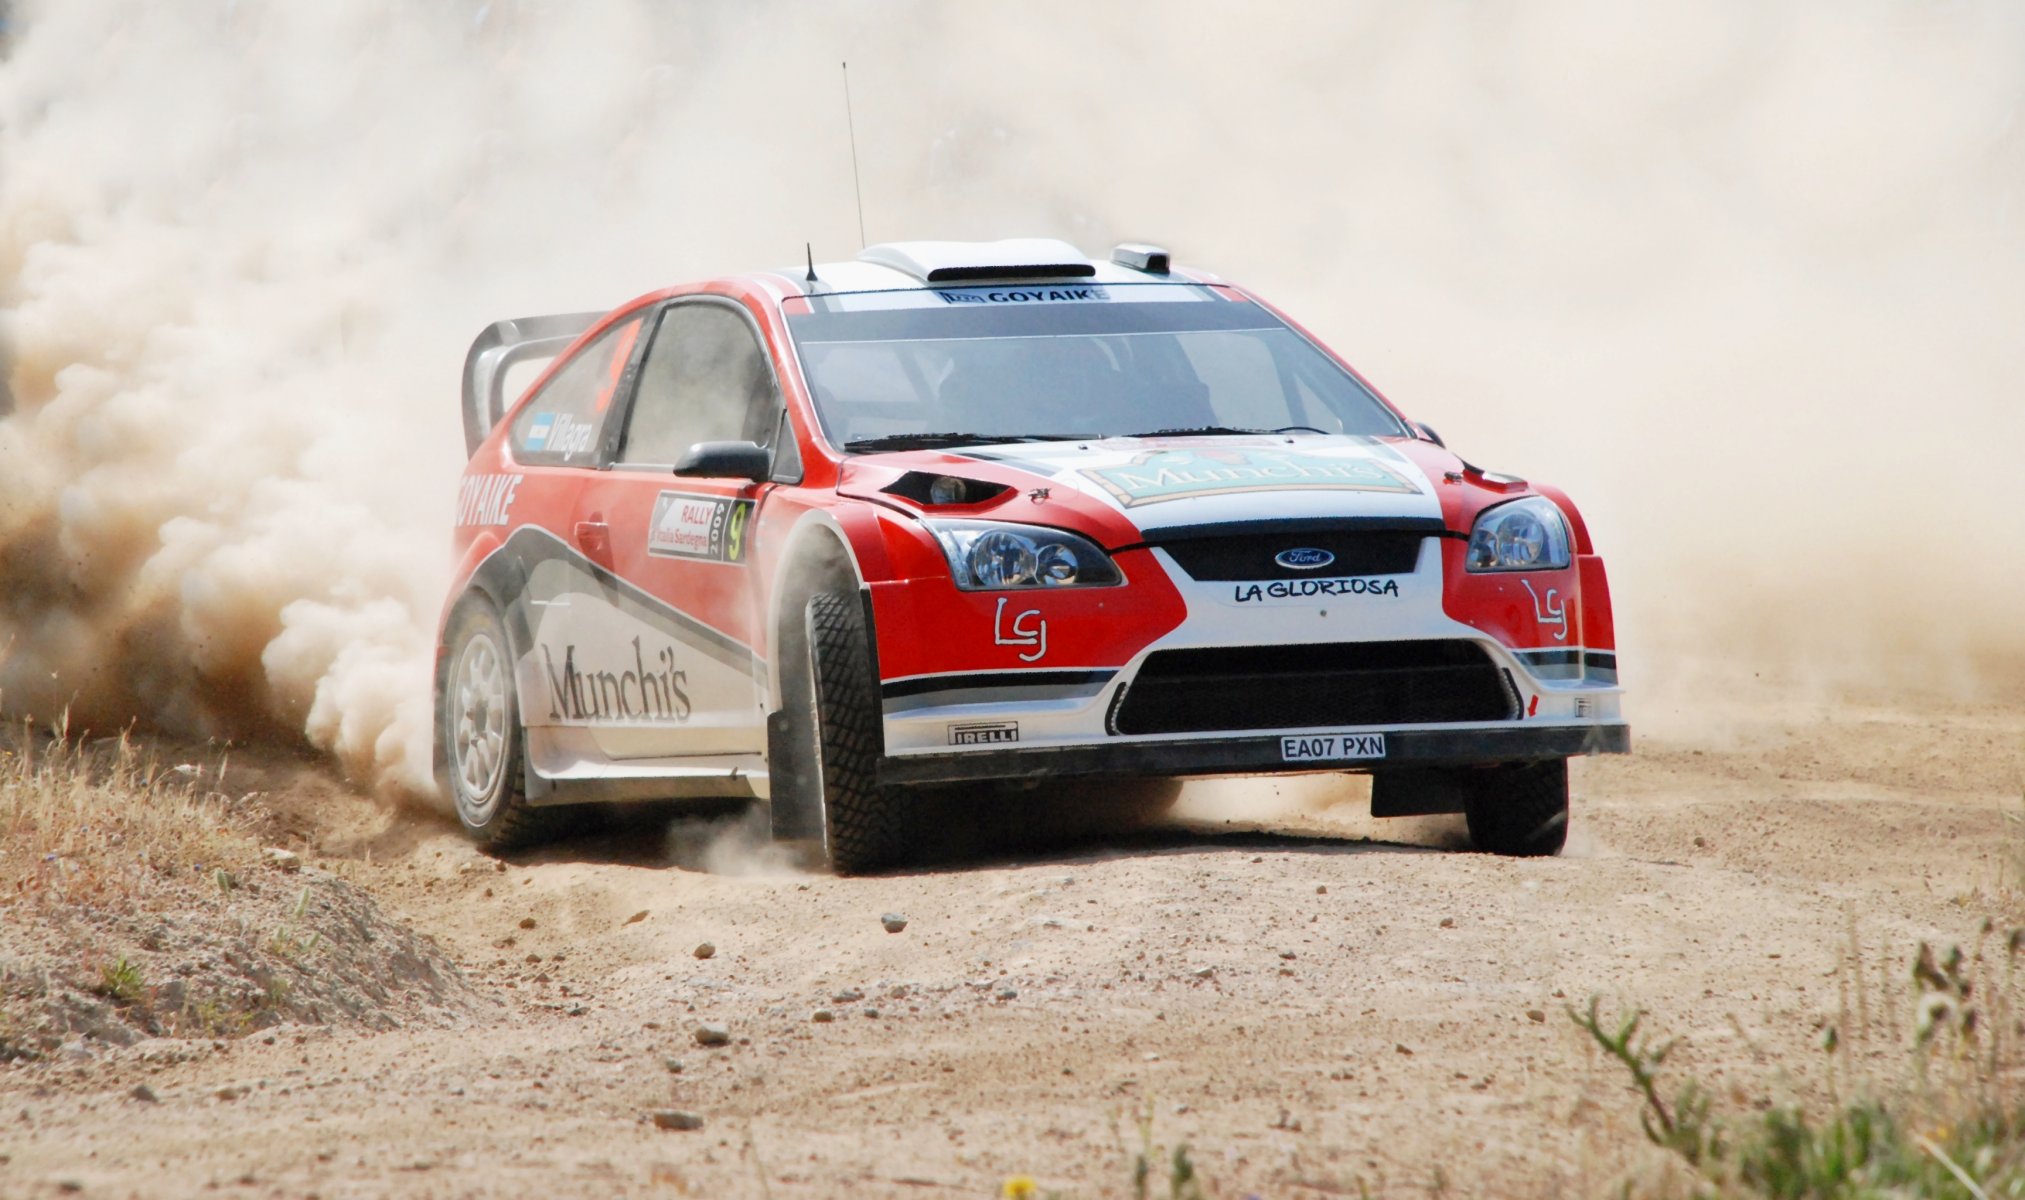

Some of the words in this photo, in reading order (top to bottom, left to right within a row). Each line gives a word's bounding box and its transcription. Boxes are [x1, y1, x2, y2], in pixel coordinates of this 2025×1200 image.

[988, 289, 1111, 302] GOYAIKE
[546, 413, 593, 461] Villagra
[1112, 459, 1383, 491] Munchi's
[681, 504, 713, 525] RALLY
[674, 528, 707, 551] Sardegna
[710, 503, 725, 554] 2009
[729, 503, 746, 560] 9
[1235, 584, 1263, 602] LA
[1267, 579, 1399, 598] GLORIOSA
[541, 635, 691, 721] Munchi's
[948, 721, 1019, 745] PIRELLI
[1284, 738, 1335, 758] EA07
[1343, 737, 1384, 755] PXN
